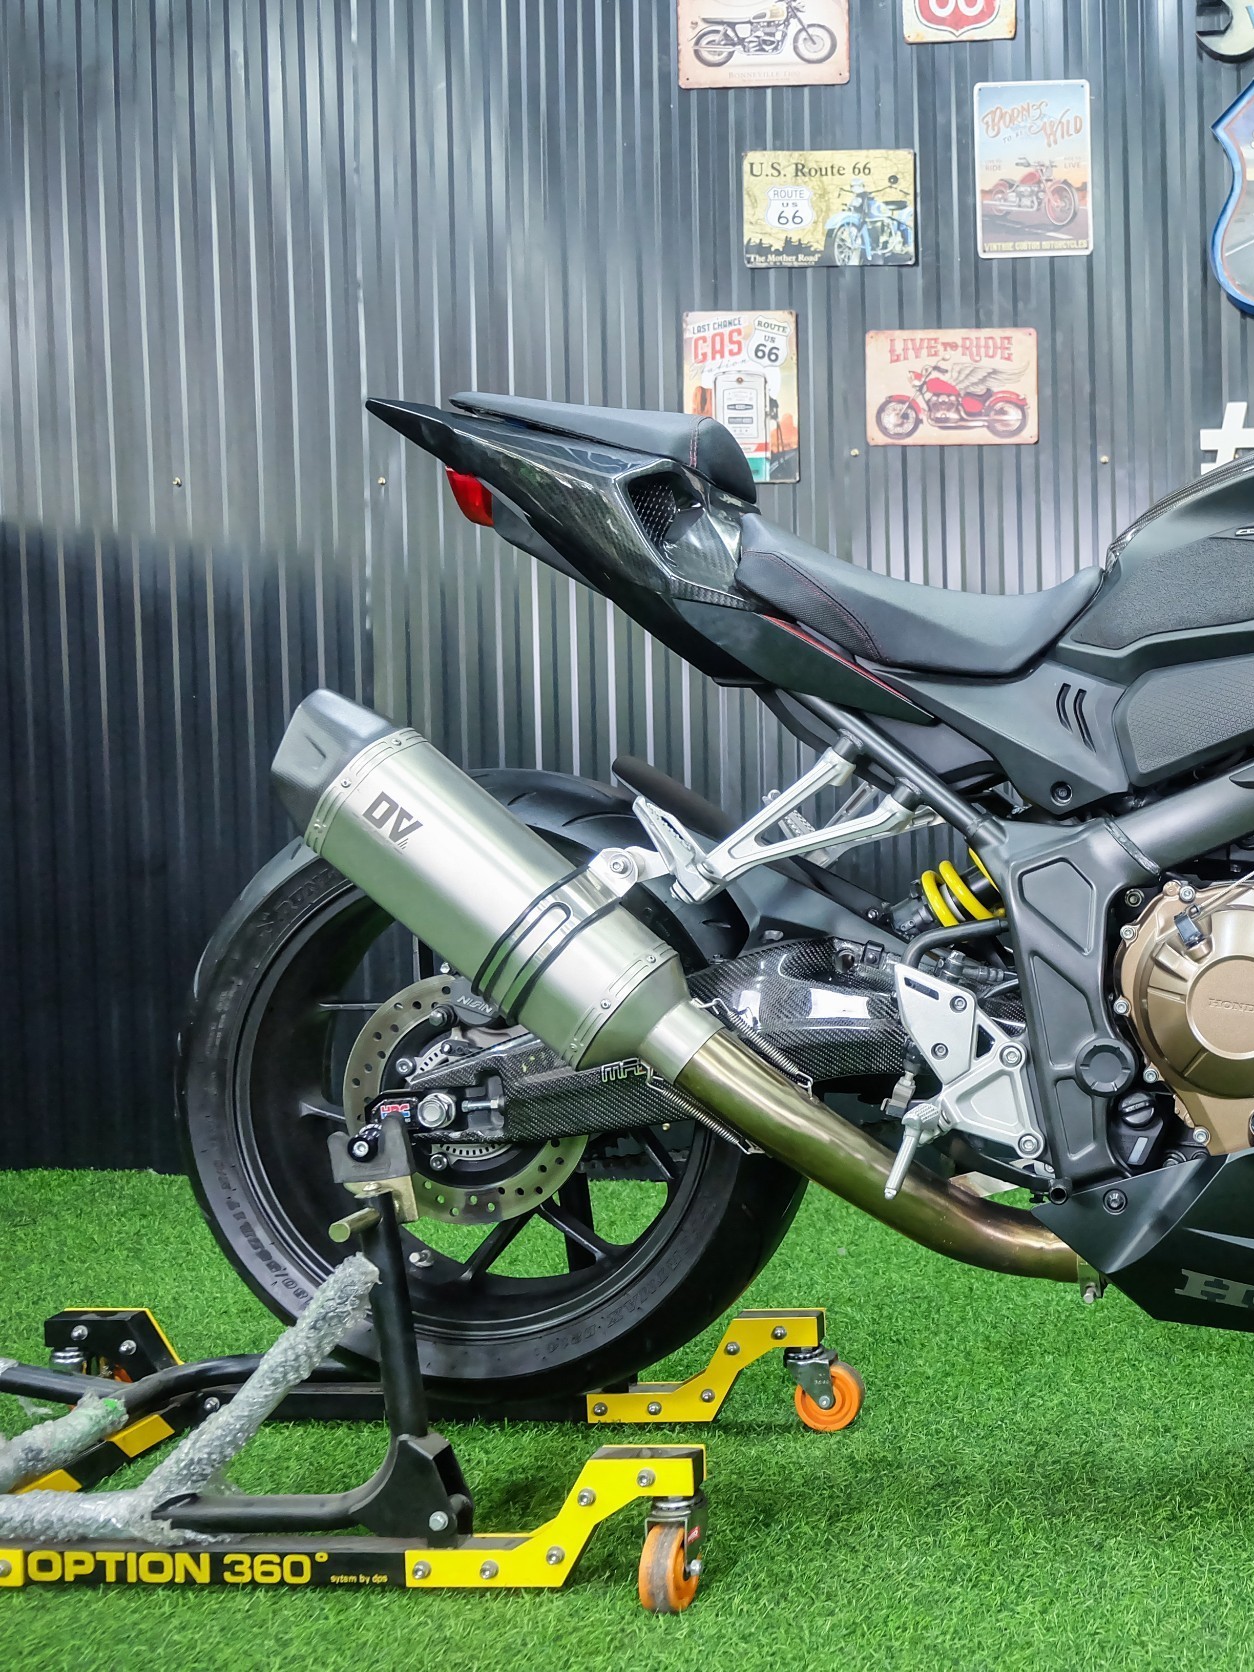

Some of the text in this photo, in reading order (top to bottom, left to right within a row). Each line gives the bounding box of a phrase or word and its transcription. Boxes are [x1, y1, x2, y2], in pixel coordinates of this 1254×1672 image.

[748, 161, 872, 178] U.S. Route 66
[773, 189, 805, 199] ROUTE
[777, 209, 804, 226] 66
[768, 253, 796, 262] Mother
[692, 317, 743, 335] LAST CHANCE
[757, 320, 788, 334] ROUTE
[693, 328, 743, 365] GAS
[763, 335, 777, 343] US
[754, 343, 780, 363] 66
[888, 337, 940, 364] LIVE
[960, 336, 1014, 363] RIDE
[457, 995, 493, 1014] NISSIN
[27, 1551, 210, 1584] OPTION
[359, 1573, 370, 1584] by
